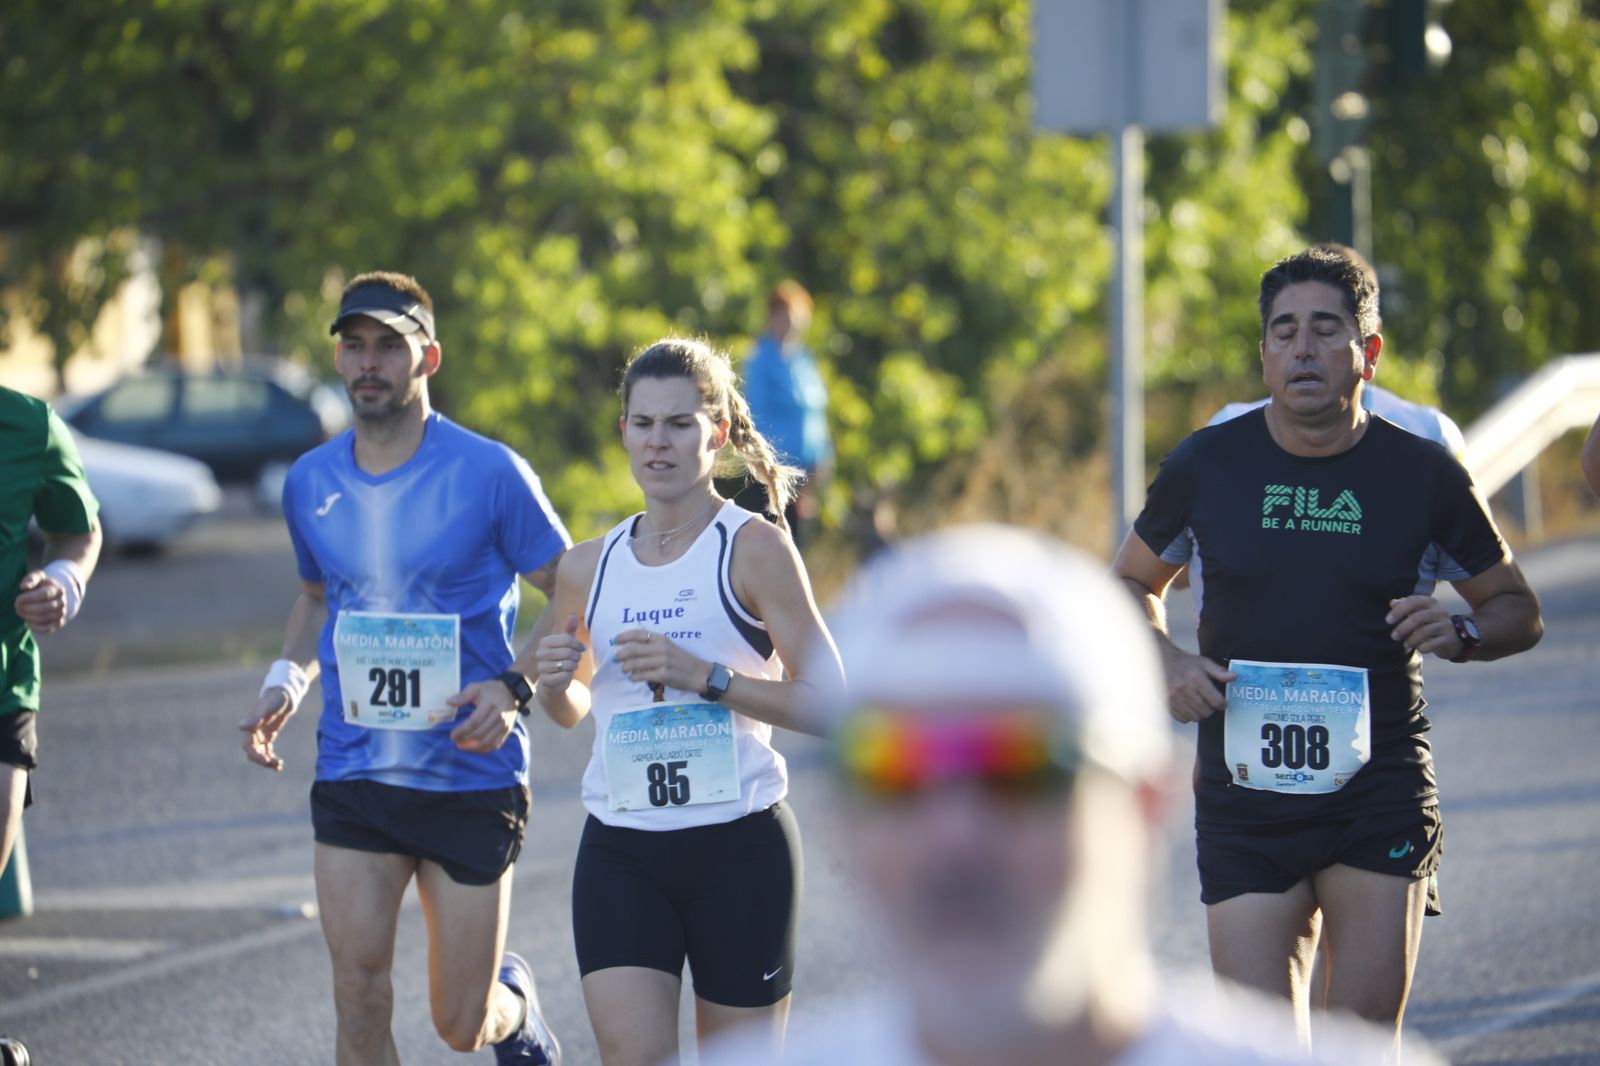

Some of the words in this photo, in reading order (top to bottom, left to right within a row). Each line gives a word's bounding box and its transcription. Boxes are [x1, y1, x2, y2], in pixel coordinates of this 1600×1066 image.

[1263, 485, 1362, 521] FILA
[1262, 517, 1280, 529] BE
[1285, 518, 1295, 530] A
[1300, 519, 1362, 535] RUNNER
[622, 606, 685, 625] Luque
[340, 633, 380, 648] MEDIA
[385, 633, 454, 649] MARATÓN
[664, 630, 702, 640] corre
[368, 667, 421, 708] 291
[1232, 686, 1278, 702] MEDIA
[1284, 687, 1363, 705] MARATÓN
[608, 729, 650, 745] MEDIA
[655, 720, 730, 741] MARATÓN
[1261, 723, 1330, 771] 308
[646, 760, 691, 807] 85
